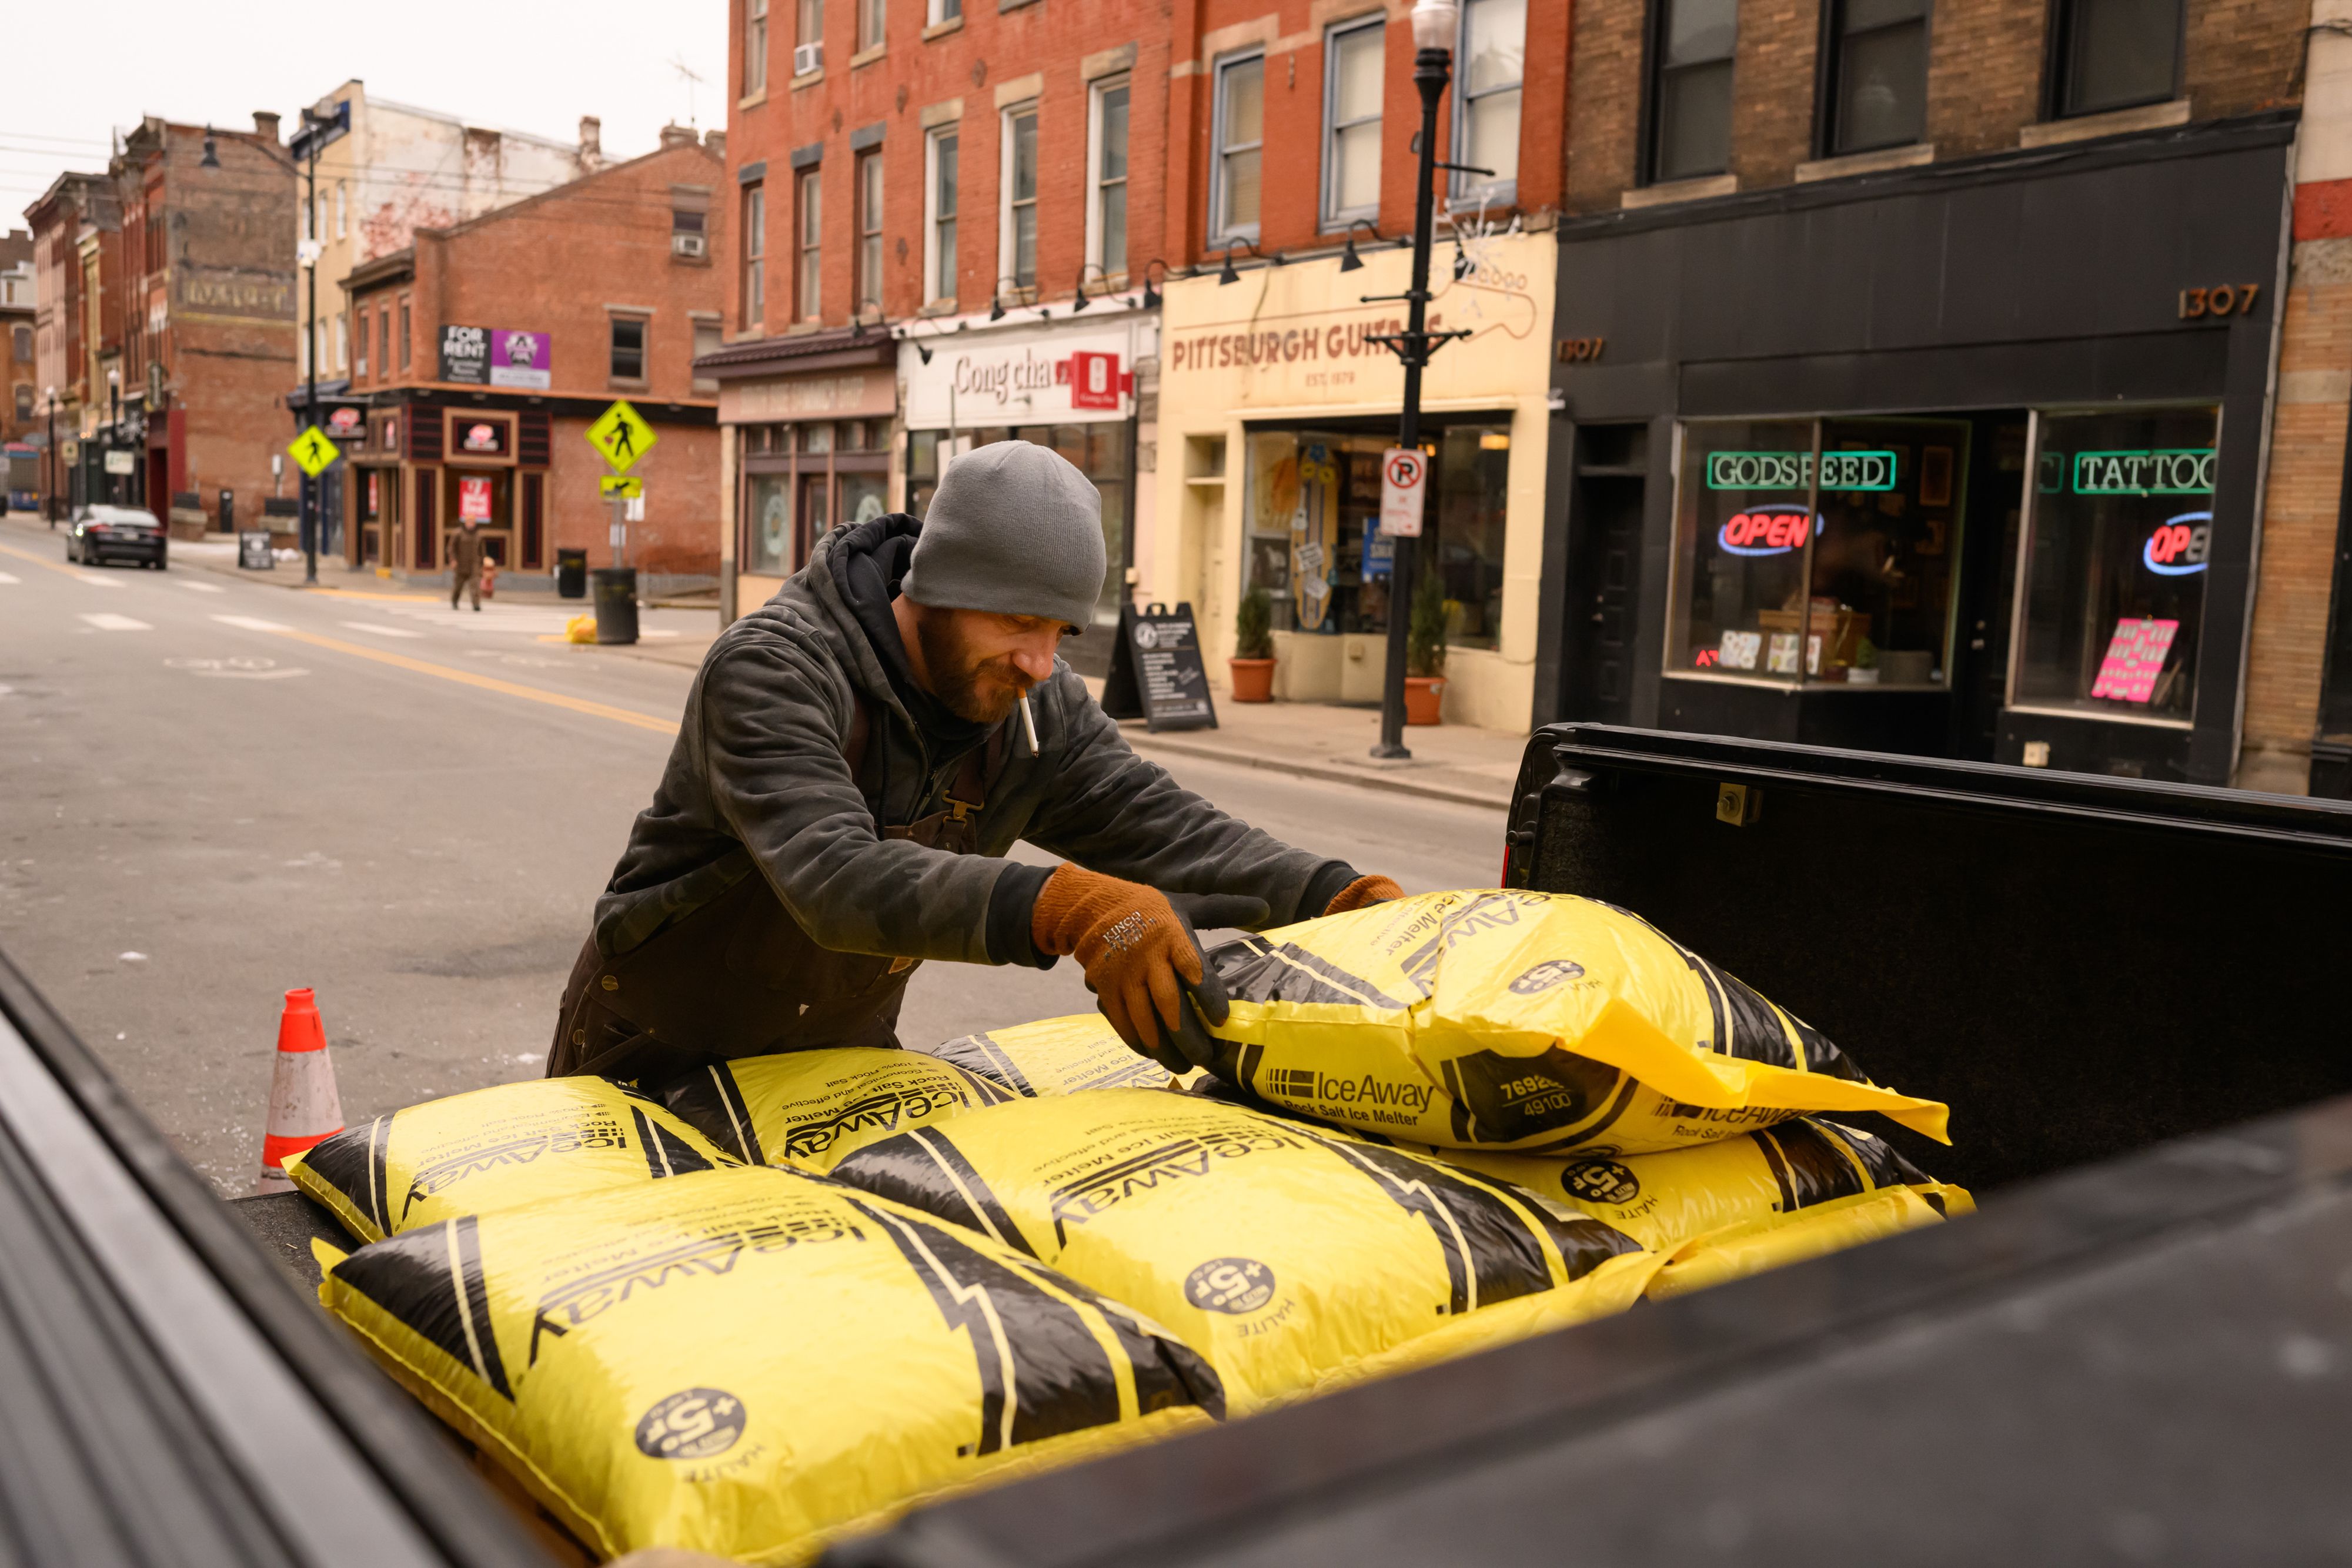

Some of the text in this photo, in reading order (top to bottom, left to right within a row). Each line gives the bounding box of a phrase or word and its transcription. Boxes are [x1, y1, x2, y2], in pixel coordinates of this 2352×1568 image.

[2177, 283, 2259, 319] 1307
[443, 339, 487, 357] RENT
[447, 325, 483, 343] FOR
[1171, 313, 1442, 372] PITTSBURGH GUITAS
[1014, 348, 1051, 390] cha
[1714, 455, 1885, 487] GODSPEED
[1724, 513, 1810, 548] OPEN
[2150, 525, 2212, 563] OPE
[1102, 911, 1141, 942] KINCO
[1386, 912, 1438, 956] Melter
[881, 1061, 912, 1071] 100%
[1055, 1048, 1115, 1075] and effective
[1063, 1063, 1110, 1086] Melter
[1110, 1054, 1134, 1065] Ice
[825, 1078, 848, 1089] Salt
[857, 1069, 923, 1091] Economical
[871, 1081, 905, 1094] Salt
[907, 1074, 950, 1088] Rock
[1318, 1071, 1435, 1114] IceAway
[781, 1095, 831, 1111] effective
[784, 1107, 841, 1125] Melter
[1284, 1099, 1418, 1126] Rock Salt Ice Melter
[1524, 1093, 1572, 1116] 49100
[784, 1091, 972, 1160] IceAway
[1099, 1131, 1127, 1146] and
[416, 1120, 617, 1169] Rock Salt Ice Melter
[1033, 1144, 1096, 1174] effective
[1117, 1138, 1152, 1155] Ice
[402, 1136, 627, 1223] IceAway
[1042, 1153, 1115, 1189] Melter
[1050, 1137, 1305, 1252] IceAway
[1614, 1194, 1658, 1220] HALITE
[540, 1249, 638, 1286] Melter
[527, 1226, 867, 1371] IceAway
[1235, 1298, 1295, 1339] HALITE
